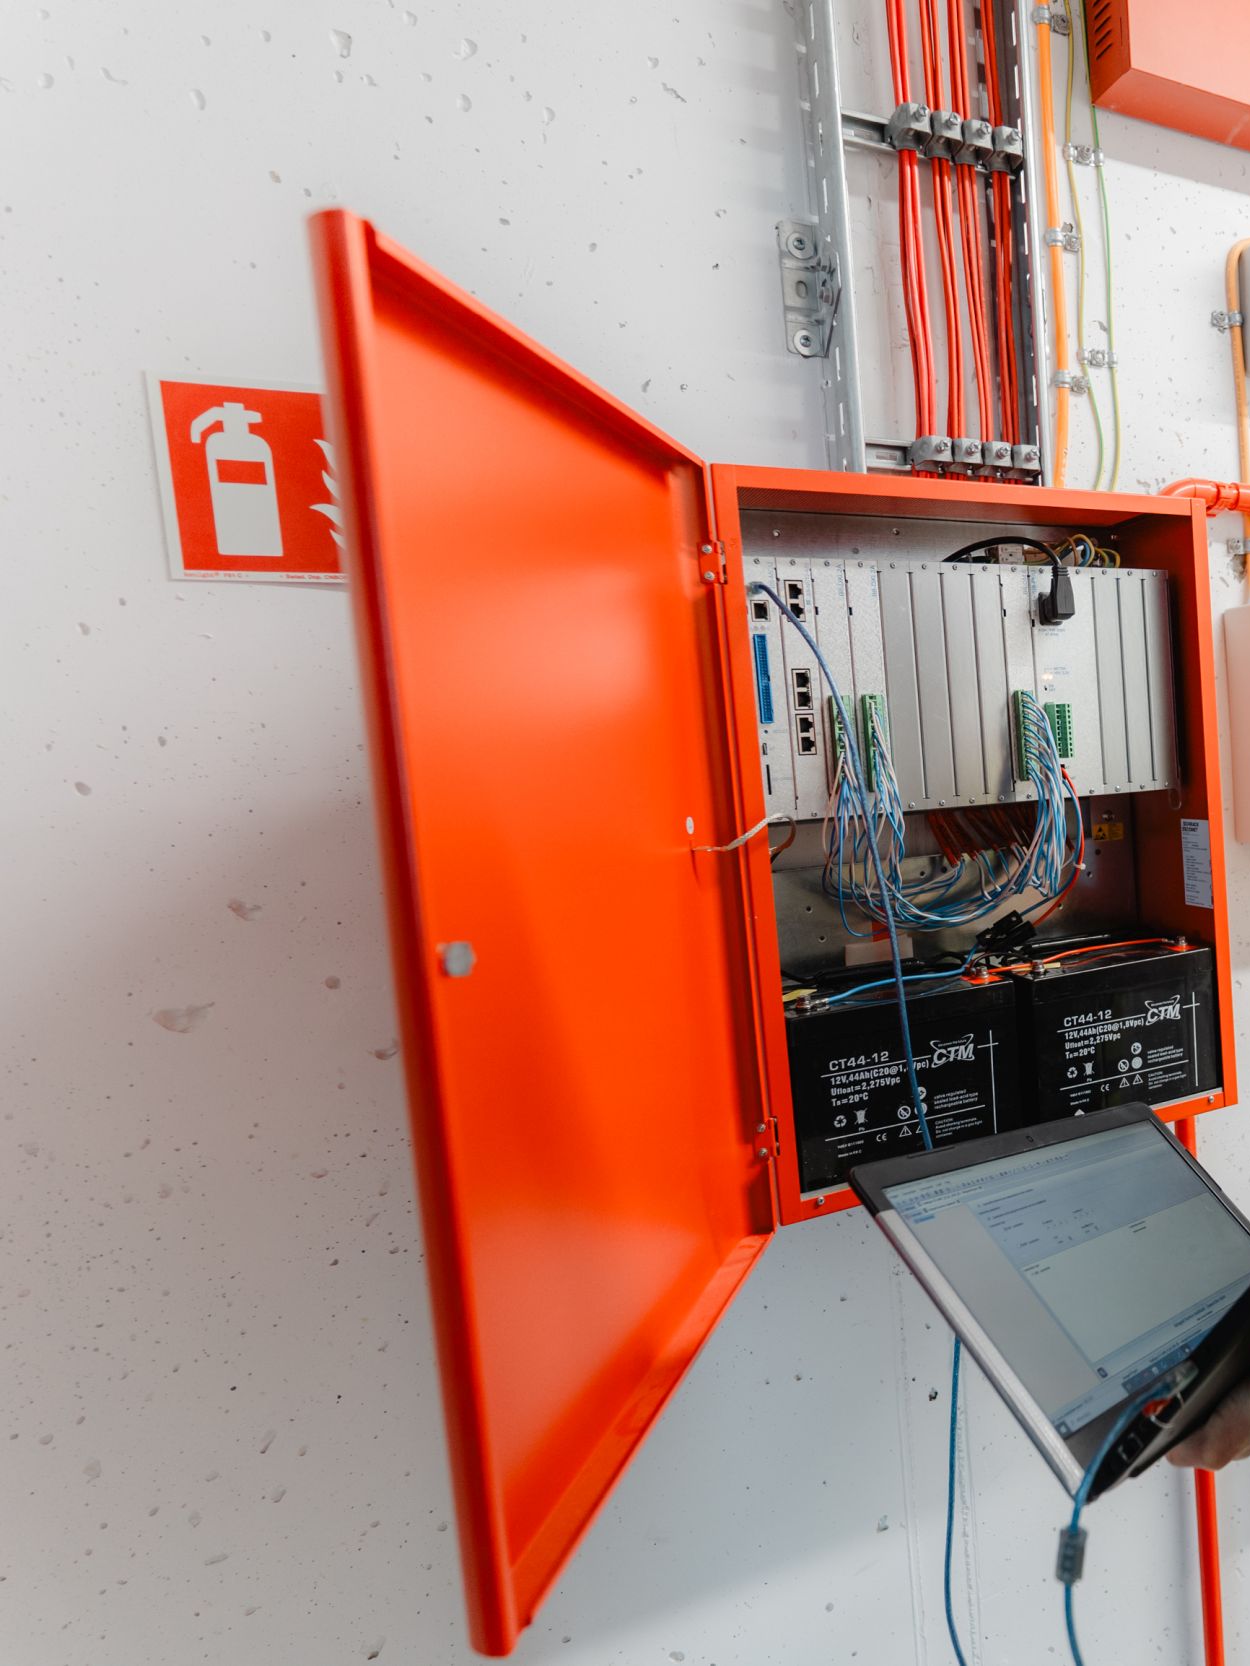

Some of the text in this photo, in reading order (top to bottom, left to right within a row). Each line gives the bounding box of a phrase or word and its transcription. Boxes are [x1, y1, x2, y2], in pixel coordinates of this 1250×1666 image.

[1064, 1010, 1112, 1027] CT44-12
[1147, 1004, 1180, 1022] CTM
[829, 1051, 890, 1071] CT44-12
[933, 1044, 974, 1064] CTM
[830, 1060, 929, 1085] 12V,44Ah(C20@1,Vpc)
[831, 1077, 901, 1096] Ufloat=2,275Vpc
